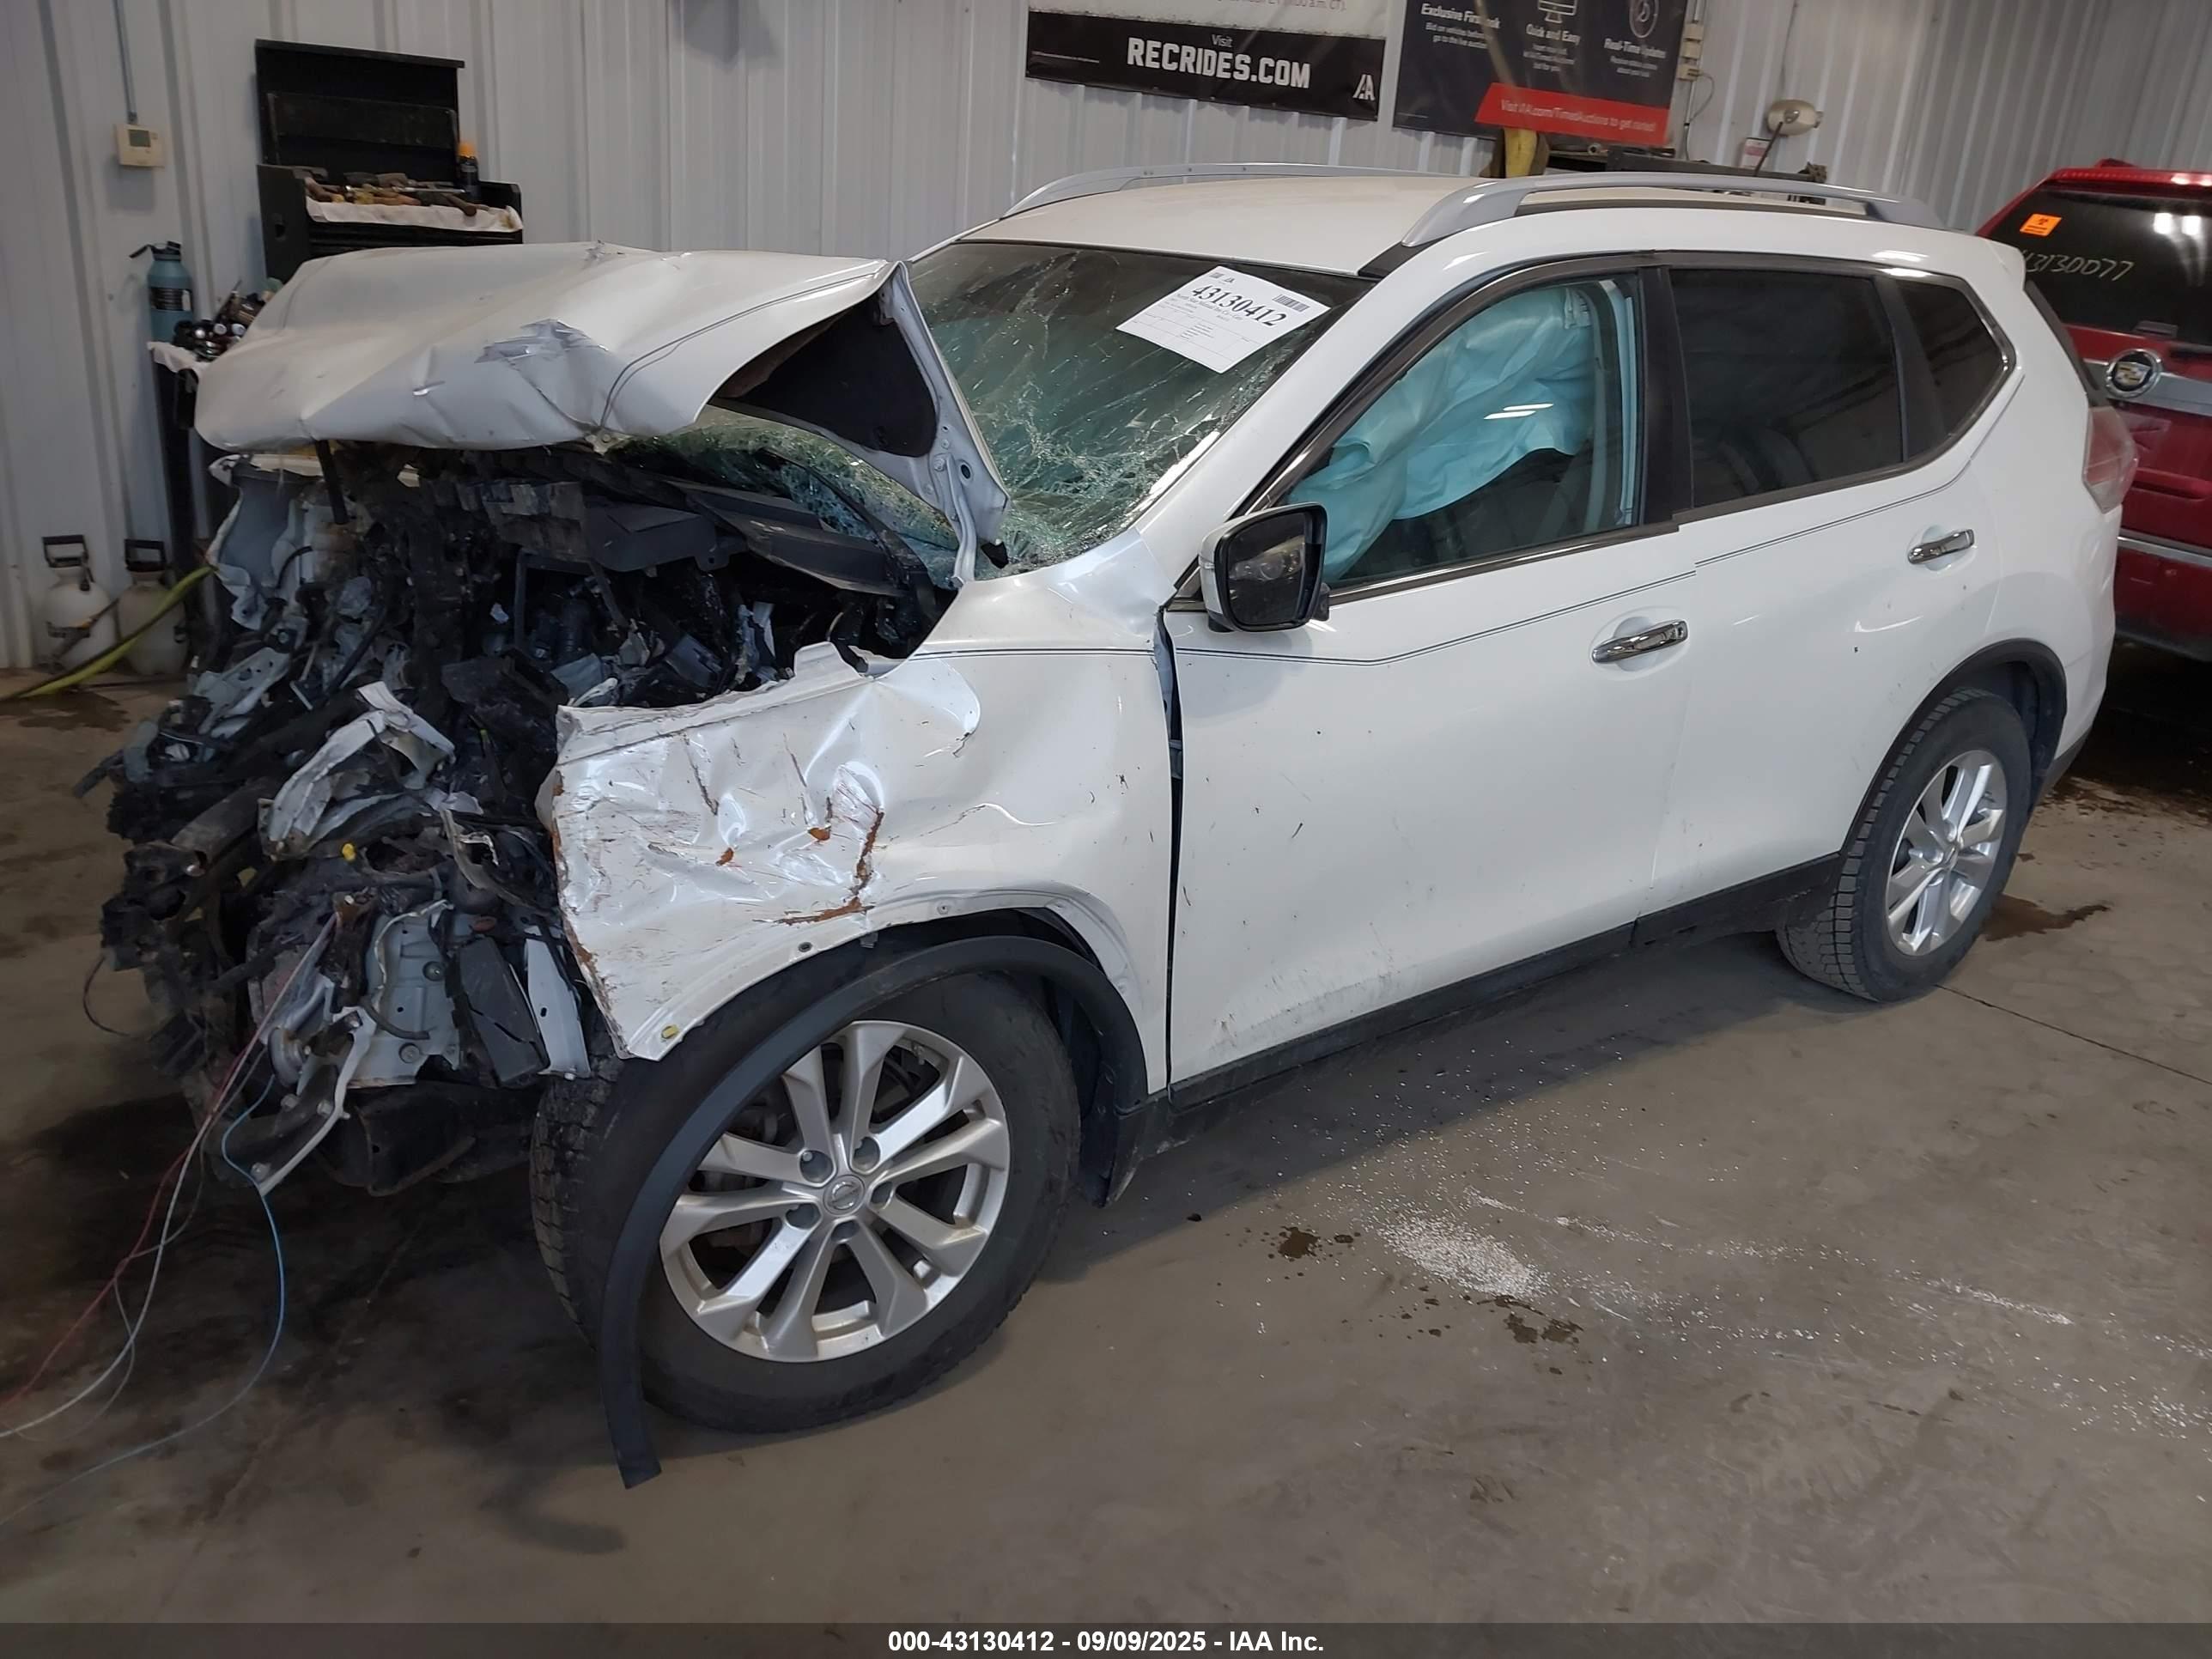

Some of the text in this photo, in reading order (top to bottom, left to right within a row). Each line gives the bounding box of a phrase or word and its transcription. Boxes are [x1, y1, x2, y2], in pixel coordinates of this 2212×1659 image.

[1421, 3, 1463, 21] Exclusive
[1212, 33, 1232, 48] Visit
[1526, 23, 1581, 46] Quick and Easy
[1604, 38, 1641, 54] Real-Time
[1127, 37, 1311, 89] RECRIDES.COM
[1501, 99, 1518, 112] Visit
[1191, 284, 1288, 326] 43130412
